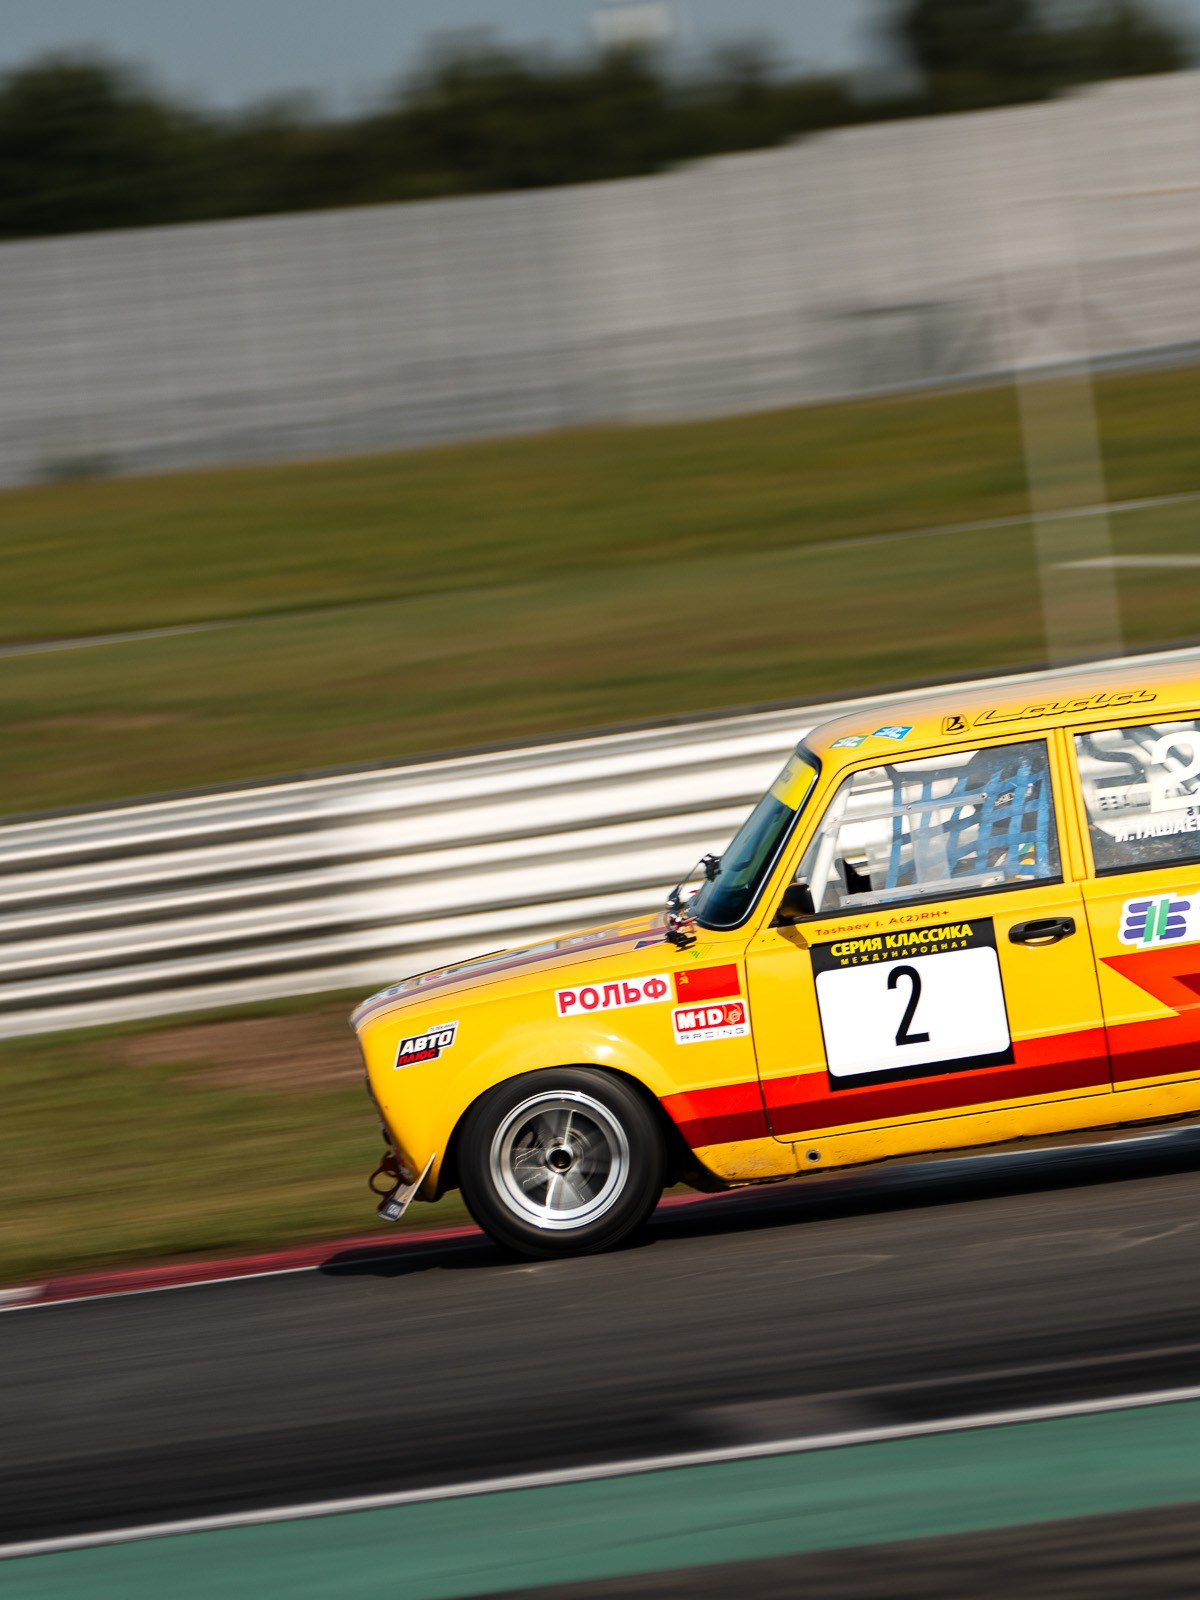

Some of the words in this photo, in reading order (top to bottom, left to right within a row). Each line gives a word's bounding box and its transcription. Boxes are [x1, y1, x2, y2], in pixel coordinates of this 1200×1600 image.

[973, 690, 1157, 727] Lada
[815, 922, 871, 936] Tashaev
[831, 937, 883, 957] СЕРИЯ
[885, 924, 974, 949] КЛАССИКА
[840, 940, 968, 966] МЕЖДУНАРОДНАЯ
[558, 978, 668, 1014] РОЛЬФ
[887, 965, 931, 1046] 2
[676, 1009, 724, 1030] M1D
[400, 1030, 453, 1055] АВТО
[680, 1026, 746, 1042] RACING
[398, 1048, 437, 1065] ПЛЮС
